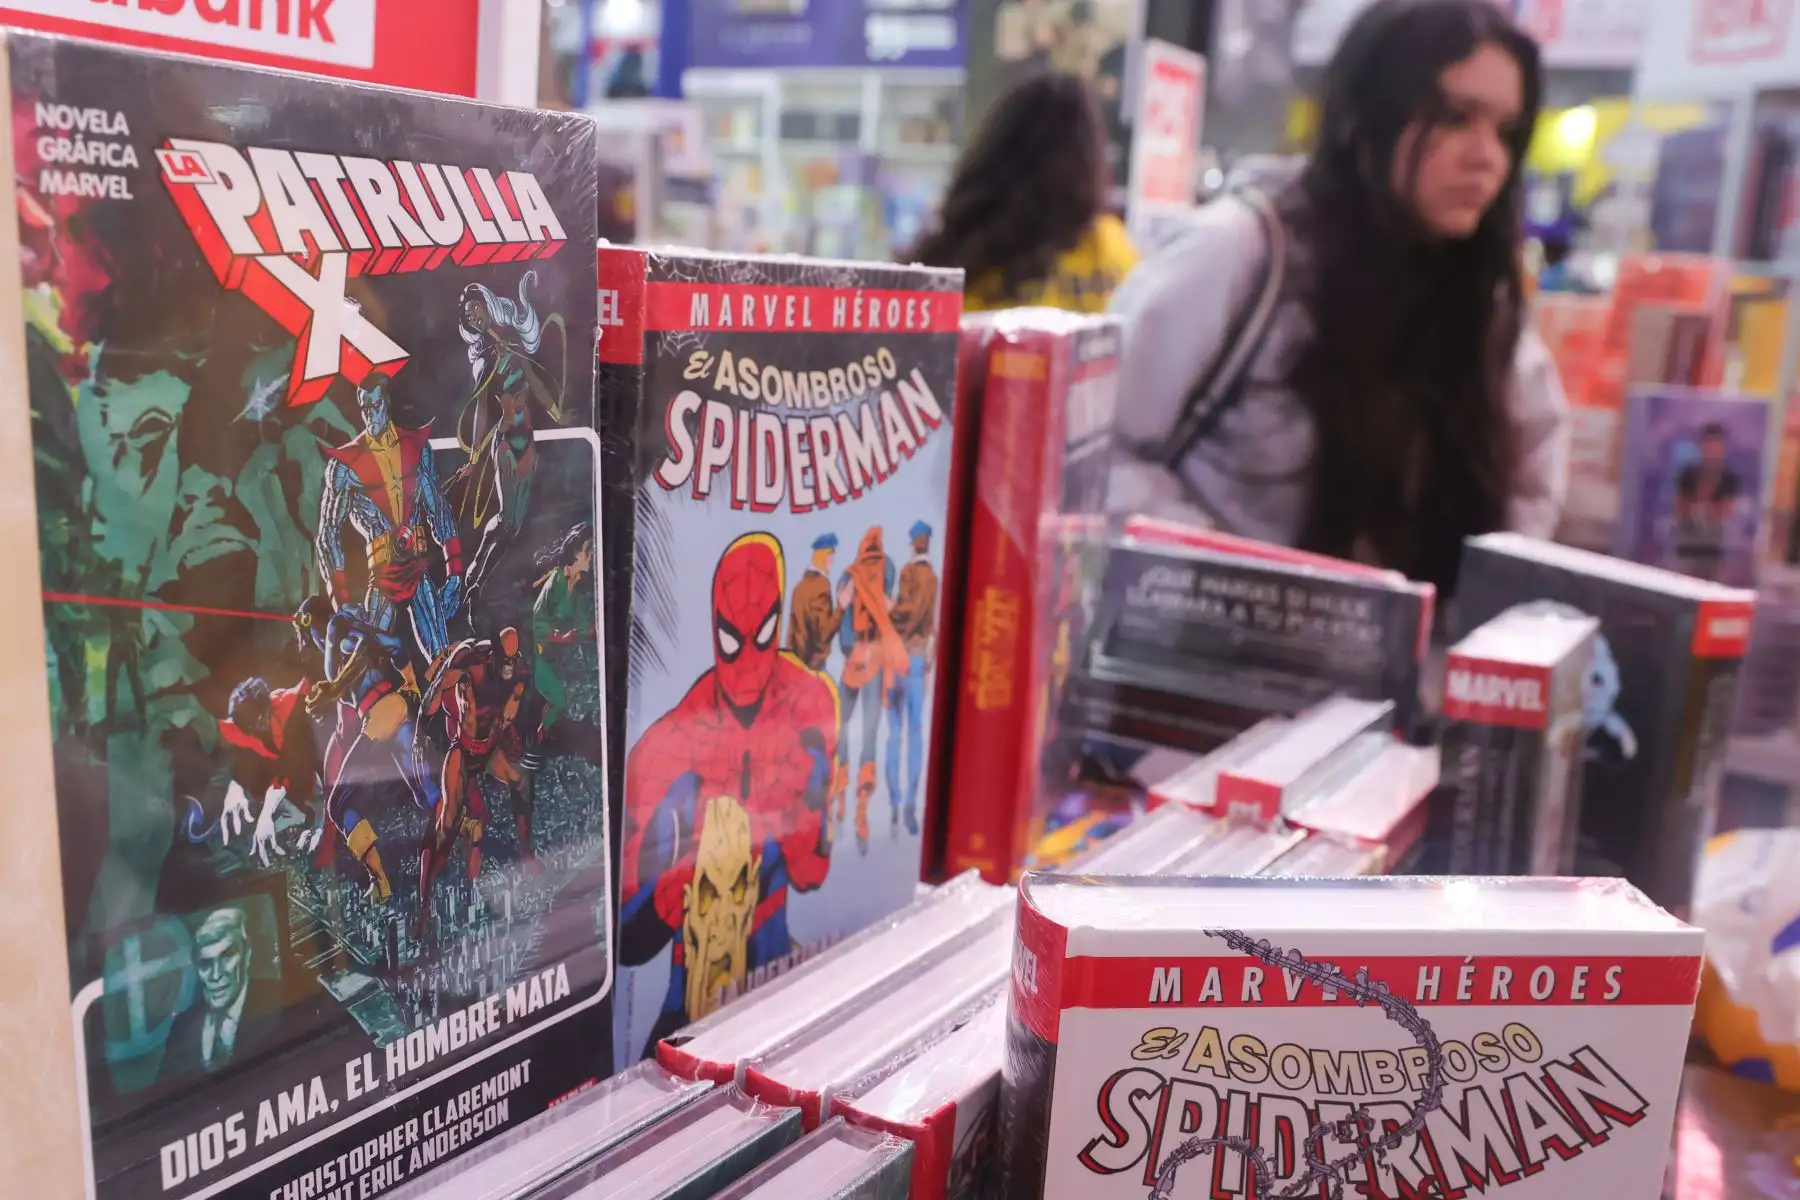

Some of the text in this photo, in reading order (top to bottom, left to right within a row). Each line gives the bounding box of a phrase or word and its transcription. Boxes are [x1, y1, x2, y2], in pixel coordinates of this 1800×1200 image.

[35, 102, 130, 135] NOVELA
[36, 135, 139, 168] GRÁFICA
[40, 170, 134, 199] MARVEL
[163, 138, 568, 268] LA PATRULLA
[248, 251, 411, 396] X
[689, 290, 933, 330] MARVEL HÉROES
[683, 346, 897, 409] El ASOMBROSO
[653, 368, 943, 514] SPIDERMAN
[1447, 668, 1545, 712] MARVEL
[1148, 956, 1624, 1003] MARV HÉROES
[159, 1111, 247, 1192] DIOS
[255, 1076, 340, 1147] AMA,
[345, 1052, 380, 1101] EL
[385, 991, 502, 1083] HOMBRE
[505, 962, 572, 1025] MATA
[1131, 1022, 1543, 1096] El ASOMBROSO
[269, 1058, 532, 1200] CHRISTOPHER CLAREMONT
[359, 1153, 406, 1200] ERIC
[408, 1098, 510, 1174] ANDERSON
[1076, 1045, 1650, 1200] SPIDERMAN
